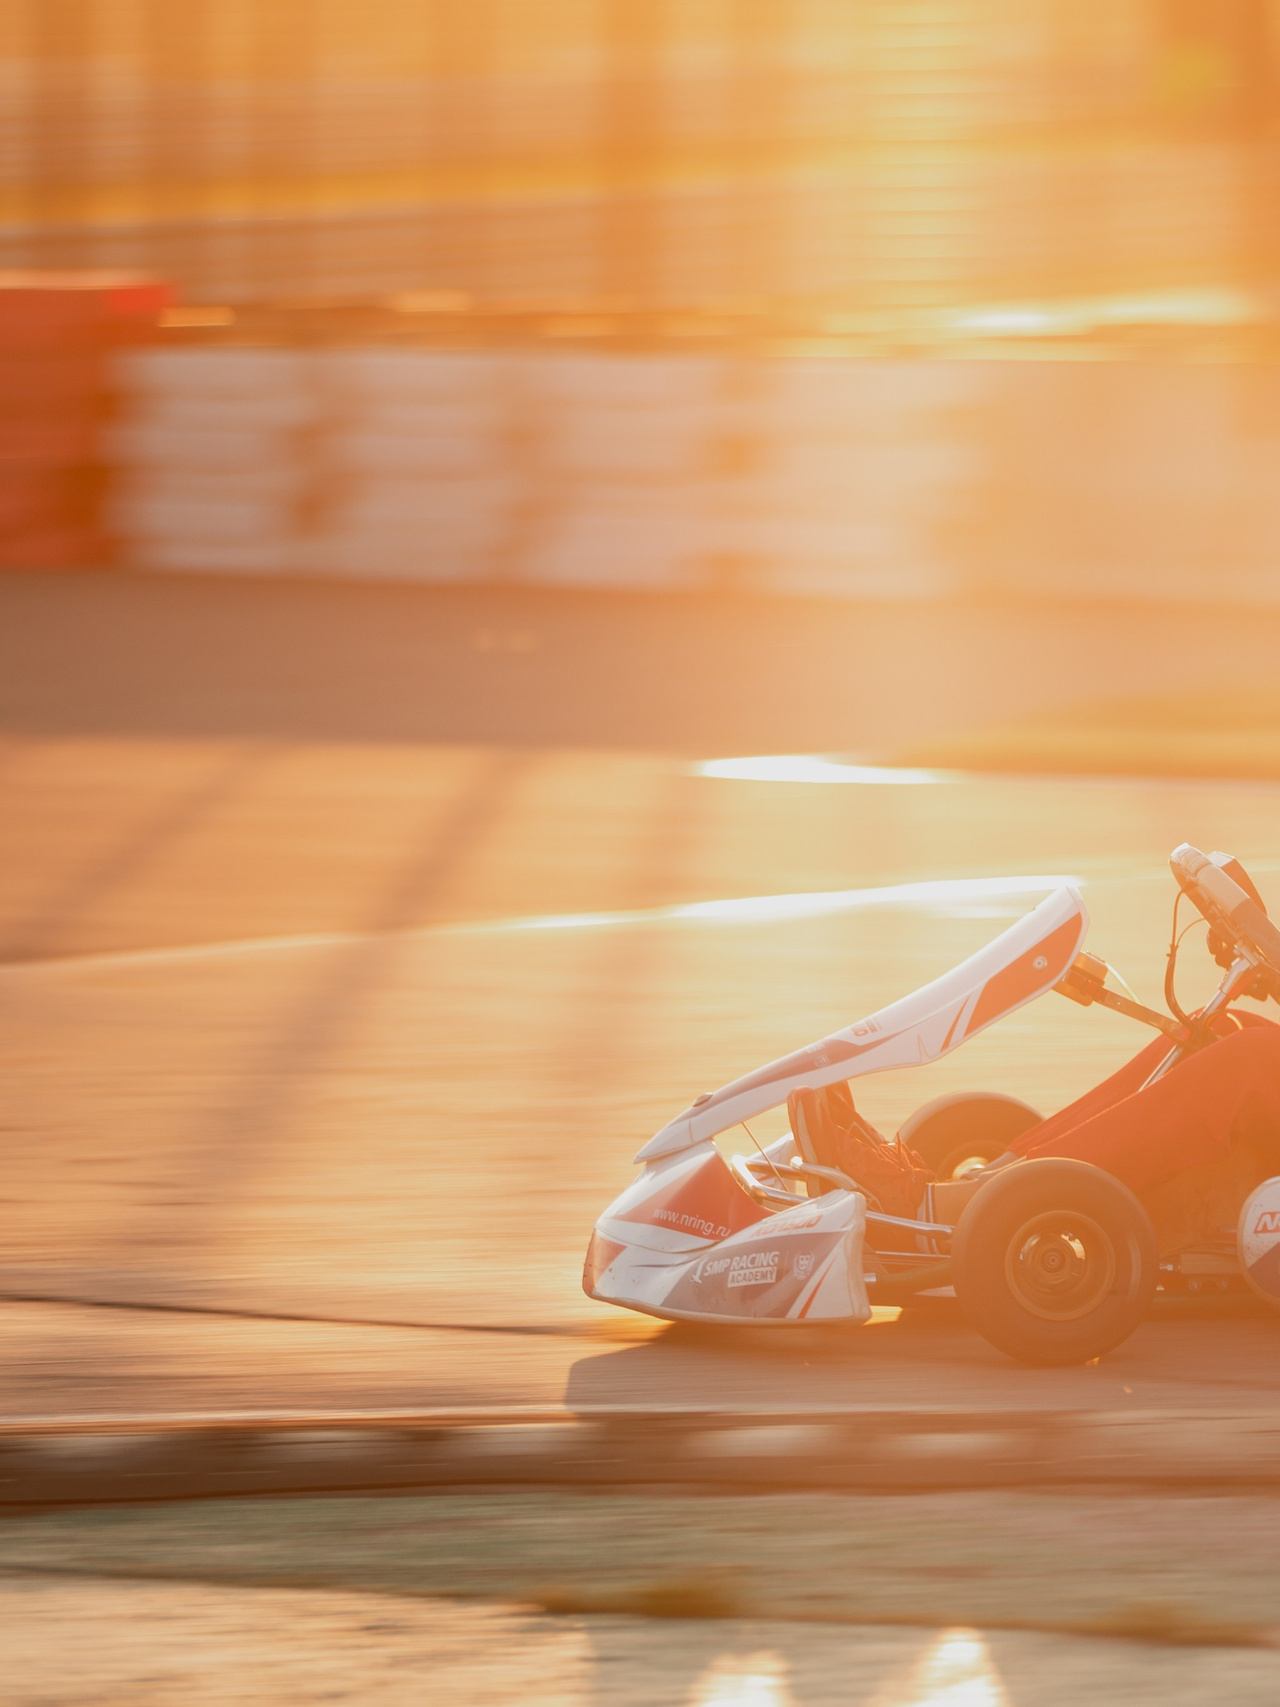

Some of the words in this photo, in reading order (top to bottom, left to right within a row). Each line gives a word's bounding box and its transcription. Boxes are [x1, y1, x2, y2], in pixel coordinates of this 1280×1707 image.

[653, 1208, 732, 1237] www.nring.ru
[704, 1258, 731, 1277] SMP
[730, 1251, 779, 1271] RACING
[730, 1268, 775, 1285] ACADEMY
